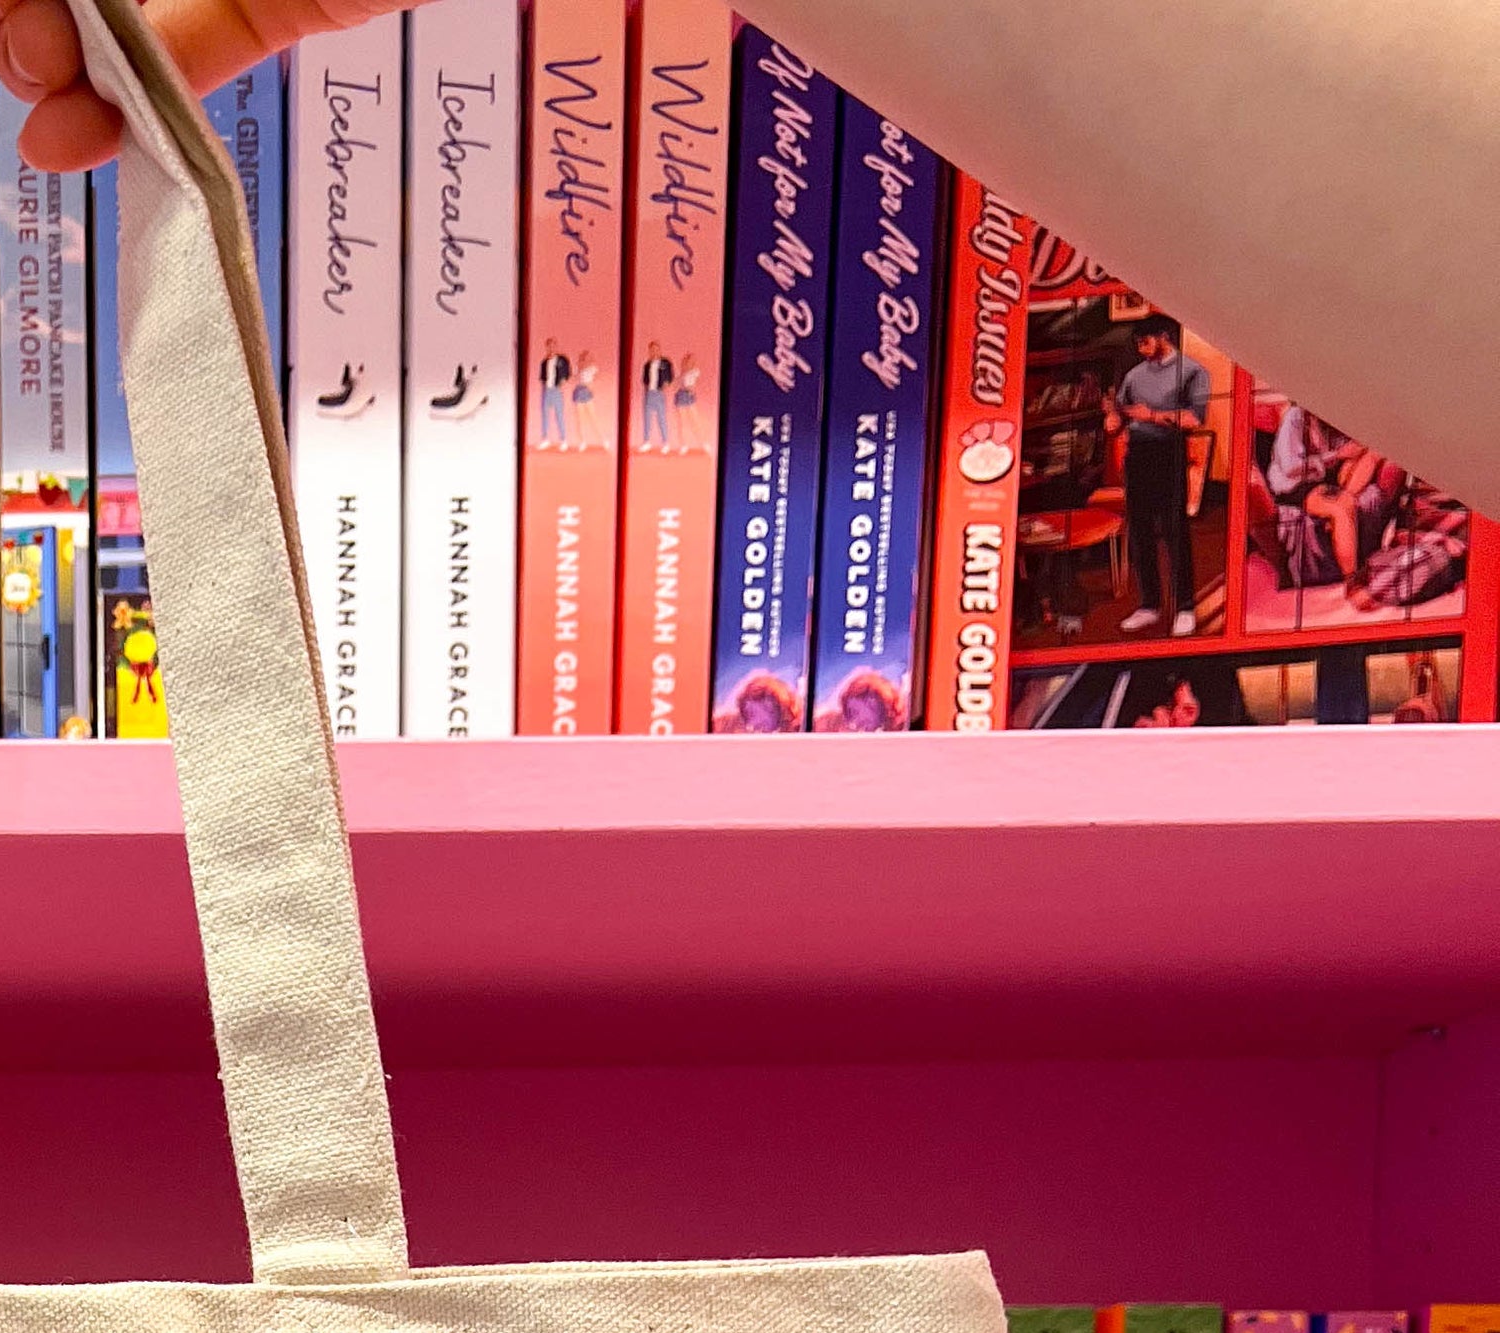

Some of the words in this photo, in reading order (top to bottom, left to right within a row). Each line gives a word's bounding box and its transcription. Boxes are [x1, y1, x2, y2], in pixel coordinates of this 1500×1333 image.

[544, 56, 612, 287] Wildfire
[650, 58, 719, 291] Wildfire
[771, 90, 813, 167] Not
[322, 68, 381, 315] Icebreaker
[436, 67, 495, 316] Icebreaker
[757, 156, 809, 220] for
[863, 154, 914, 217] for
[757, 220, 814, 290] My
[862, 217, 919, 289] My
[757, 294, 814, 394] Baby
[862, 291, 919, 389] Baby
[971, 266, 1022, 404] Issues
[748, 416, 774, 503] KATE
[852, 414, 878, 500] KATE
[337, 495, 357, 627] HANNAH
[449, 496, 469, 629] HANNAH
[555, 505, 581, 641] HANNAH
[654, 508, 681, 644] HANNAH
[740, 516, 768, 655] GOLDEN
[843, 515, 873, 654] GOLDEN
[962, 523, 1002, 612] KATE
[336, 640, 357, 737] GRACE
[447, 641, 469, 738] GRACE
